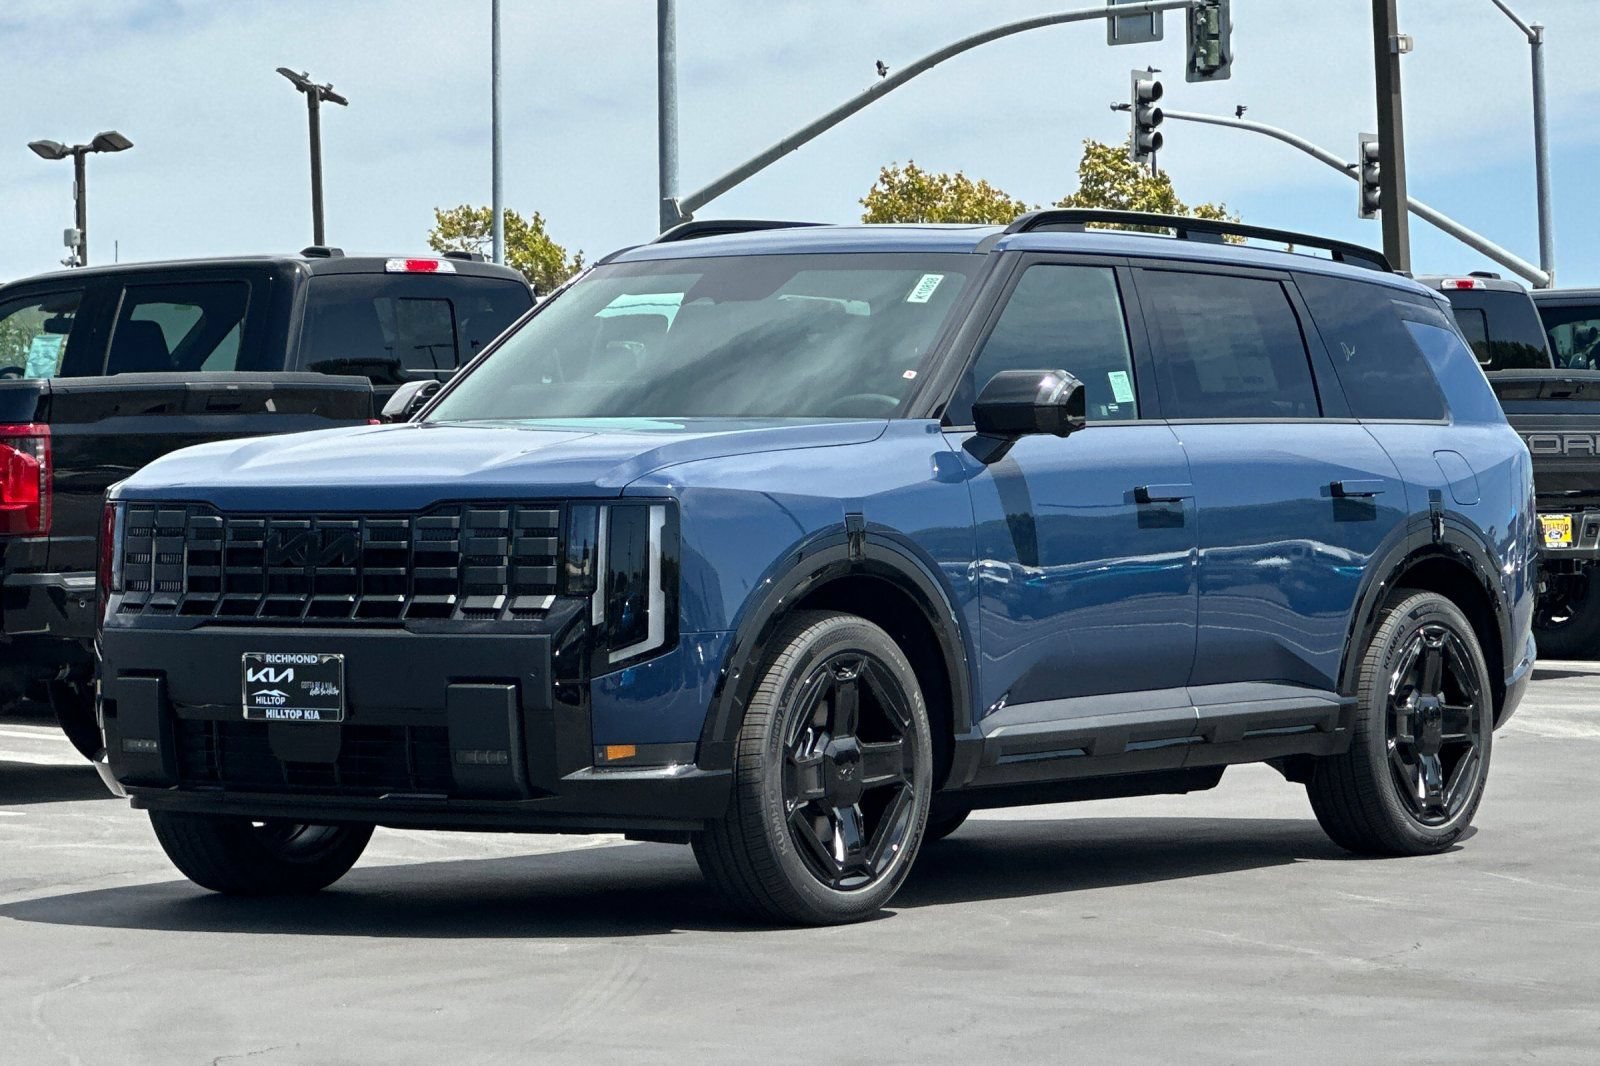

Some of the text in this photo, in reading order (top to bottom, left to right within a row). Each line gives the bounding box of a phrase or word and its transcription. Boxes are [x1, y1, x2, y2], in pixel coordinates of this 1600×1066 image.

[1520, 434, 1600, 454] OR
[1383, 624, 1406, 670] KUMHO
[265, 654, 318, 664] RICHMOND
[247, 667, 294, 683] KIA
[255, 696, 286, 705] HILLTOP
[265, 709, 320, 720] HILLTOP KIA
[769, 790, 788, 856] KUMHO
